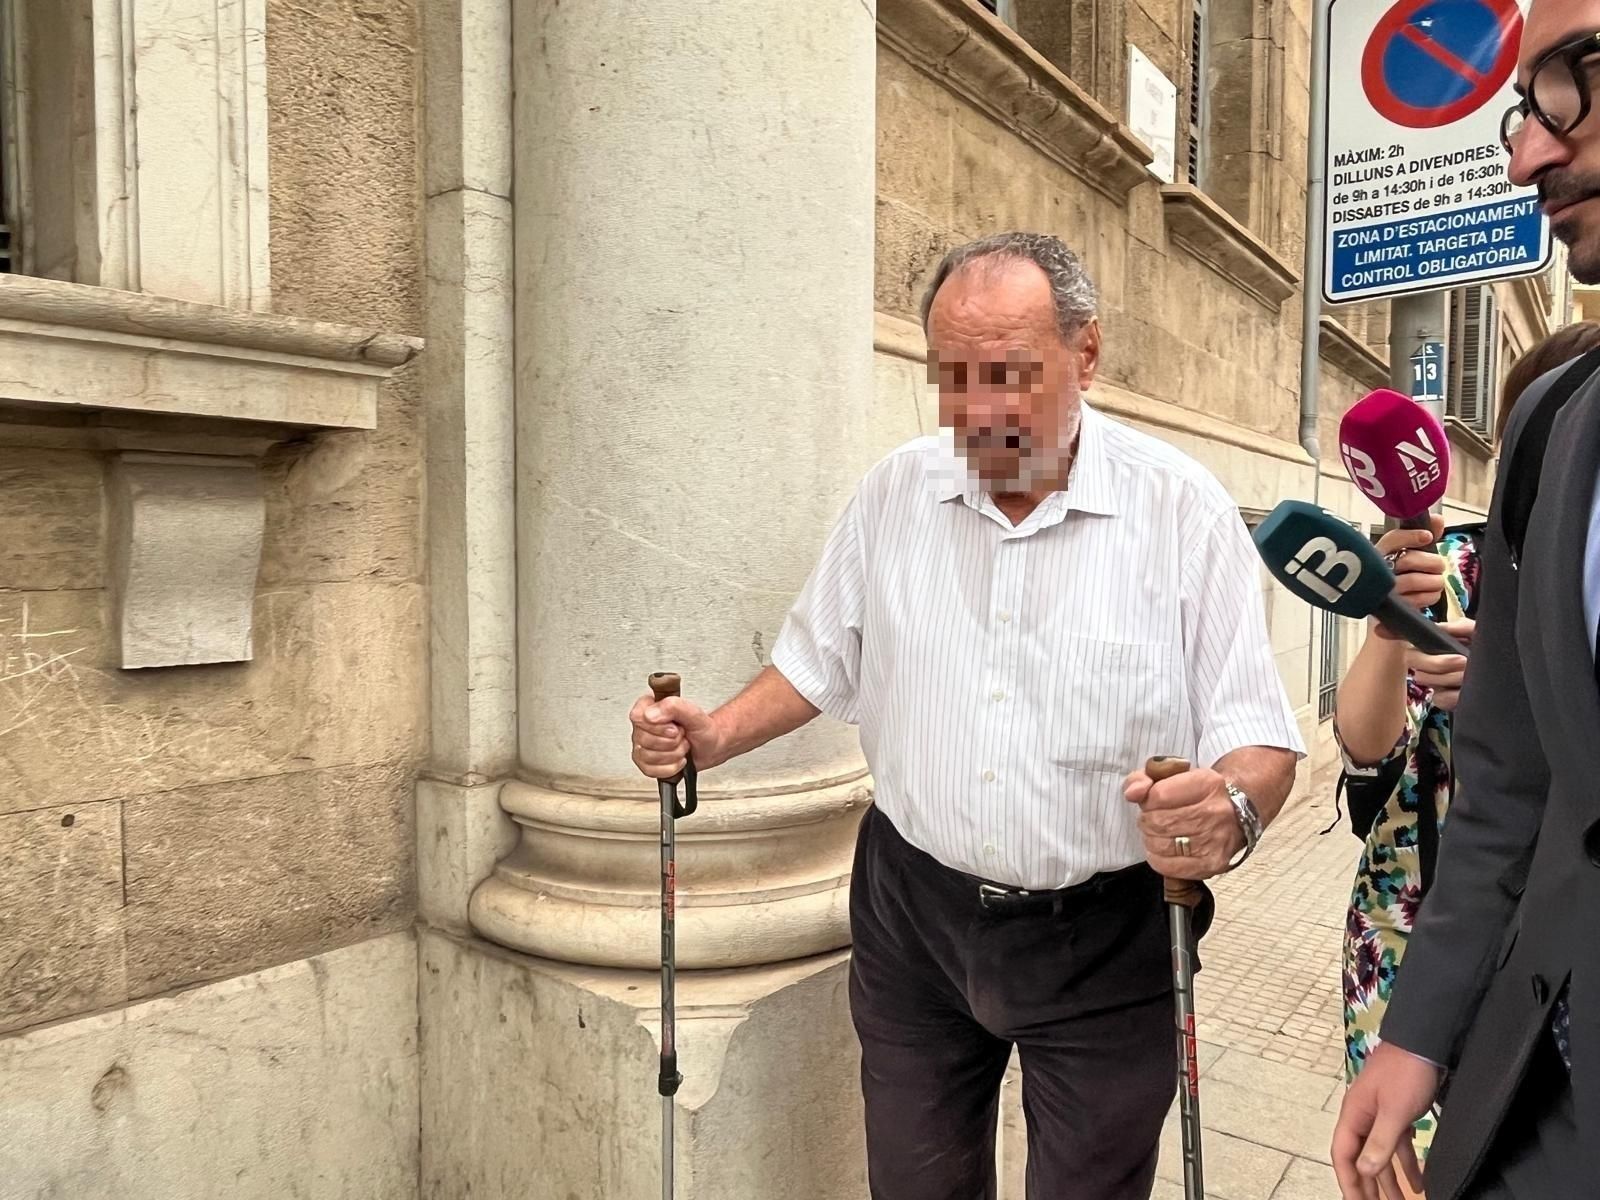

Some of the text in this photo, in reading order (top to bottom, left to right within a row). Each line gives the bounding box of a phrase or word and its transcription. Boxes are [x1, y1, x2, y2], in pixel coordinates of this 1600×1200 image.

[1333, 144, 1500, 186] DILLUNS A DIVENDRES:
[1334, 144, 1405, 168] MÀXIM: 2h
[1333, 163, 1504, 205] de 9h a 14:30h i de 16:30h
[1333, 181, 1512, 224] DISSABTES de 9h a 14:30h
[1337, 199, 1538, 248] ZONA D'ESTACIONAMENT
[1341, 245, 1528, 288] CONTROL OBLIGATÒRIA
[1354, 225, 1516, 266] LIMITAT. TARGETA DE
